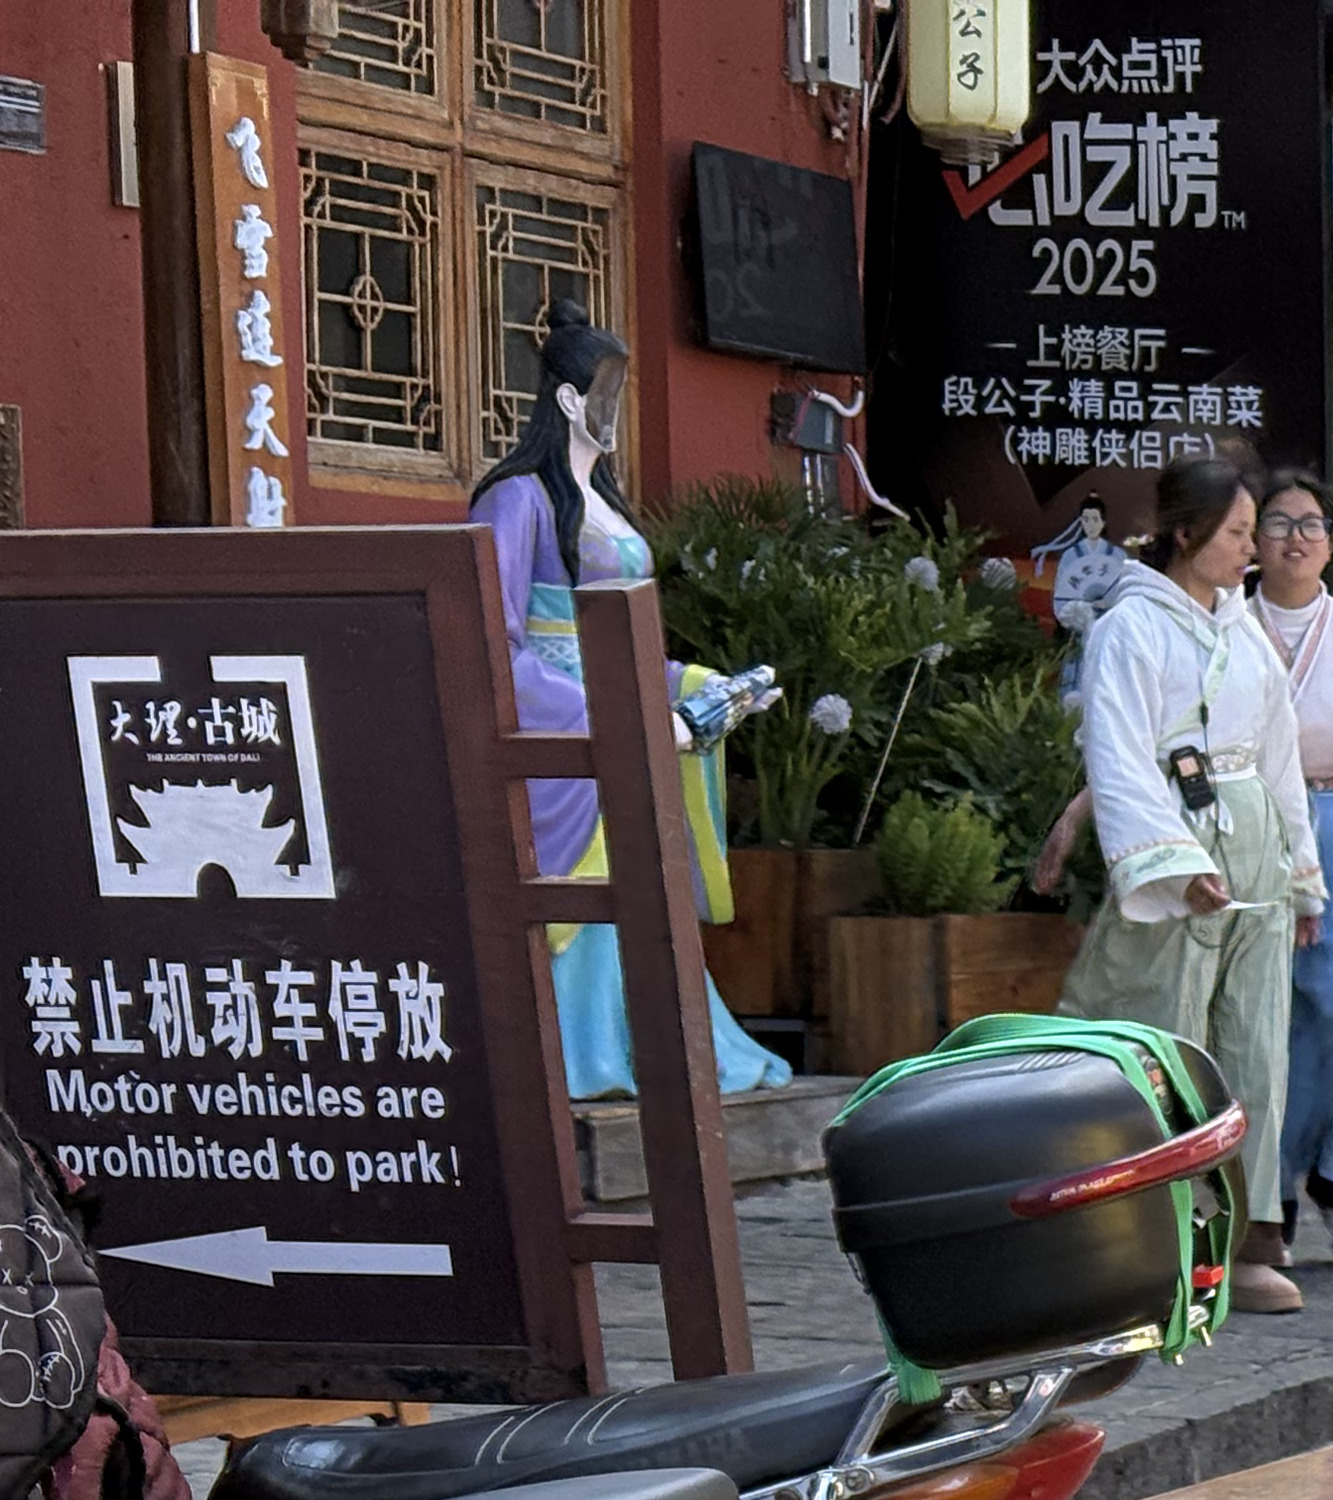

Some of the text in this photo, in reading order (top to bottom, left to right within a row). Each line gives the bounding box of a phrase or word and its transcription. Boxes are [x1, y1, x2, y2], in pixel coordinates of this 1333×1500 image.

[952, 0, 987, 91] 公子
[1036, 38, 1202, 93] 大众点评
[1030, 238, 1157, 297] 2025
[1026, 324, 1167, 372] 上榜餐厅
[942, 375, 1263, 428] 段公子·精品云南菜
[110, 697, 282, 746] 大理·古城
[23, 957, 453, 1063] 禁止机动车停放
[46, 1069, 447, 1119] Motor vehicles are
[57, 1135, 281, 1181] prohibited
[287, 1141, 336, 1183] to
